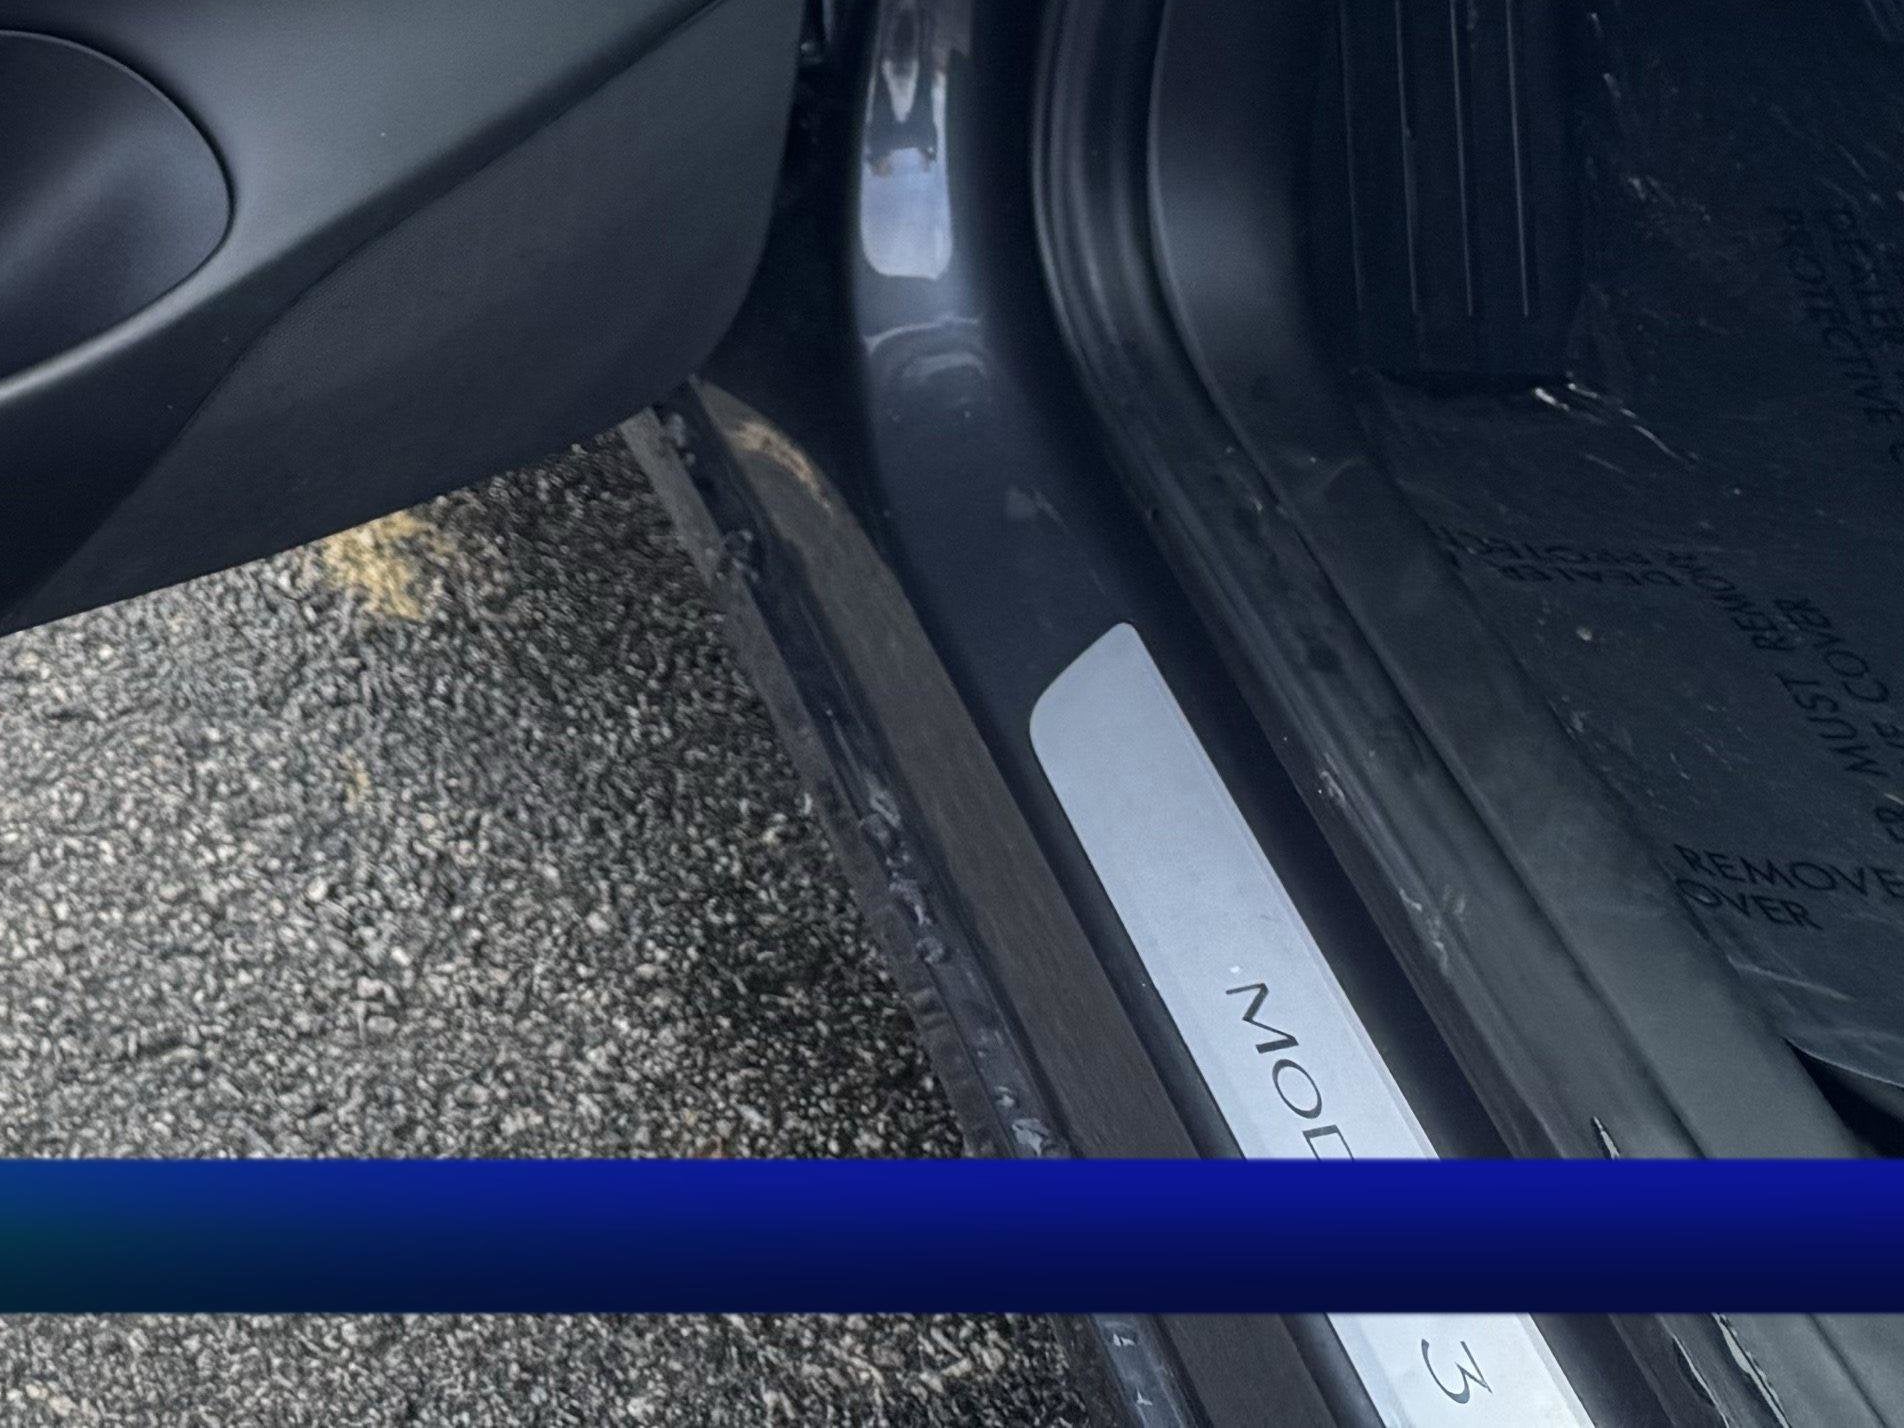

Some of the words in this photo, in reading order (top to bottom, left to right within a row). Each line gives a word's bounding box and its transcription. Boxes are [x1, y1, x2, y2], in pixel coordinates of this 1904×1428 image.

[1773, 598, 1891, 704] COVER
[1776, 672, 1890, 778] MUST
[1673, 843, 1904, 899] REMOVE
[1422, 1338, 1493, 1405] 3
